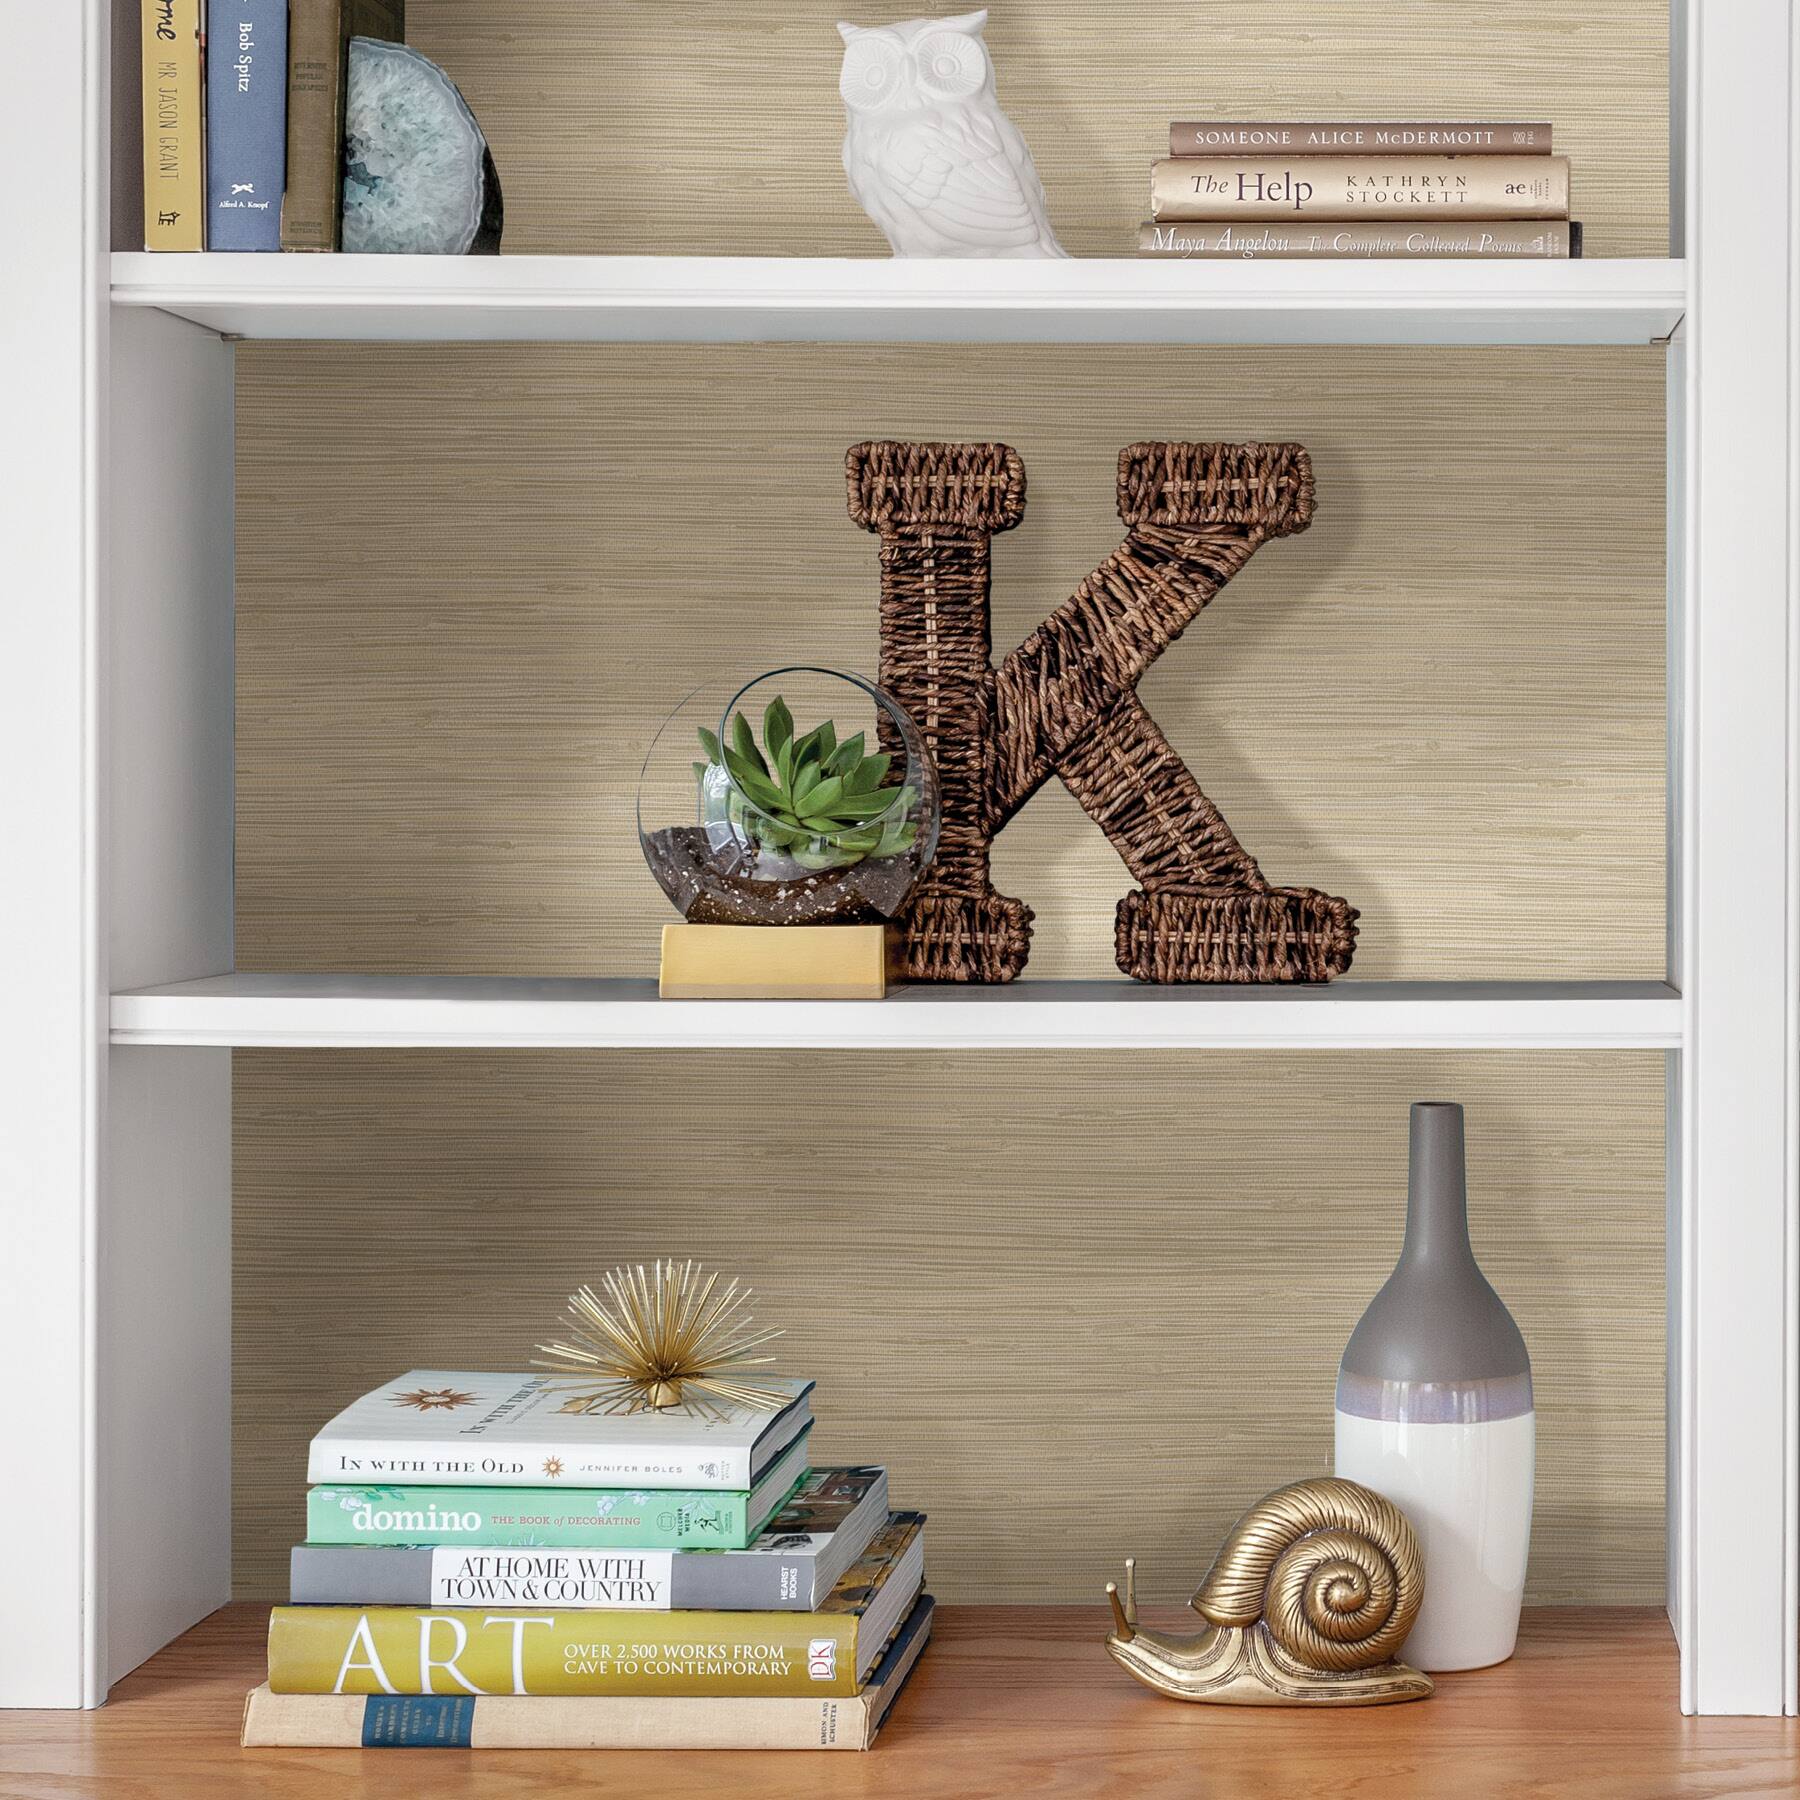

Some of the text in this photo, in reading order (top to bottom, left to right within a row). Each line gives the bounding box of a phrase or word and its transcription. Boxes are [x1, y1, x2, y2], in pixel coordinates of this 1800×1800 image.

[233, 22, 255, 92] Bob Spitz
[158, 62, 179, 180] MR JASON GRANT
[1195, 131, 1495, 145] SOMEONE ALICE McDERMOTT
[1191, 171, 1313, 210] The Help
[1346, 175, 1468, 187] KATHRYN
[218, 200, 237, 208] Alfred
[1346, 191, 1468, 203] STOCKETT
[1151, 227, 1290, 258] Maya Angelou
[1307, 232, 1522, 257] The Complete Collected Poems
[578, 1464, 683, 1473] JENNIFER BOLES
[352, 1503, 482, 1531] domino
[491, 1515, 641, 1527] THE BOOK of DECORATING
[457, 1556, 646, 1580] AT HOME WITH
[544, 1579, 663, 1602] COUNTRY
[780, 1566, 789, 1600] HEARST
[789, 1567, 798, 1599] BOOKS
[331, 1613, 555, 1695] ART
[563, 1644, 785, 1660] OVER 2,500 WORKS FROM
[809, 1642, 833, 1678] DK
[563, 1661, 792, 1676] CAVE TO CONTEMPORARY
[828, 1703, 837, 1743] SCHUSTER
